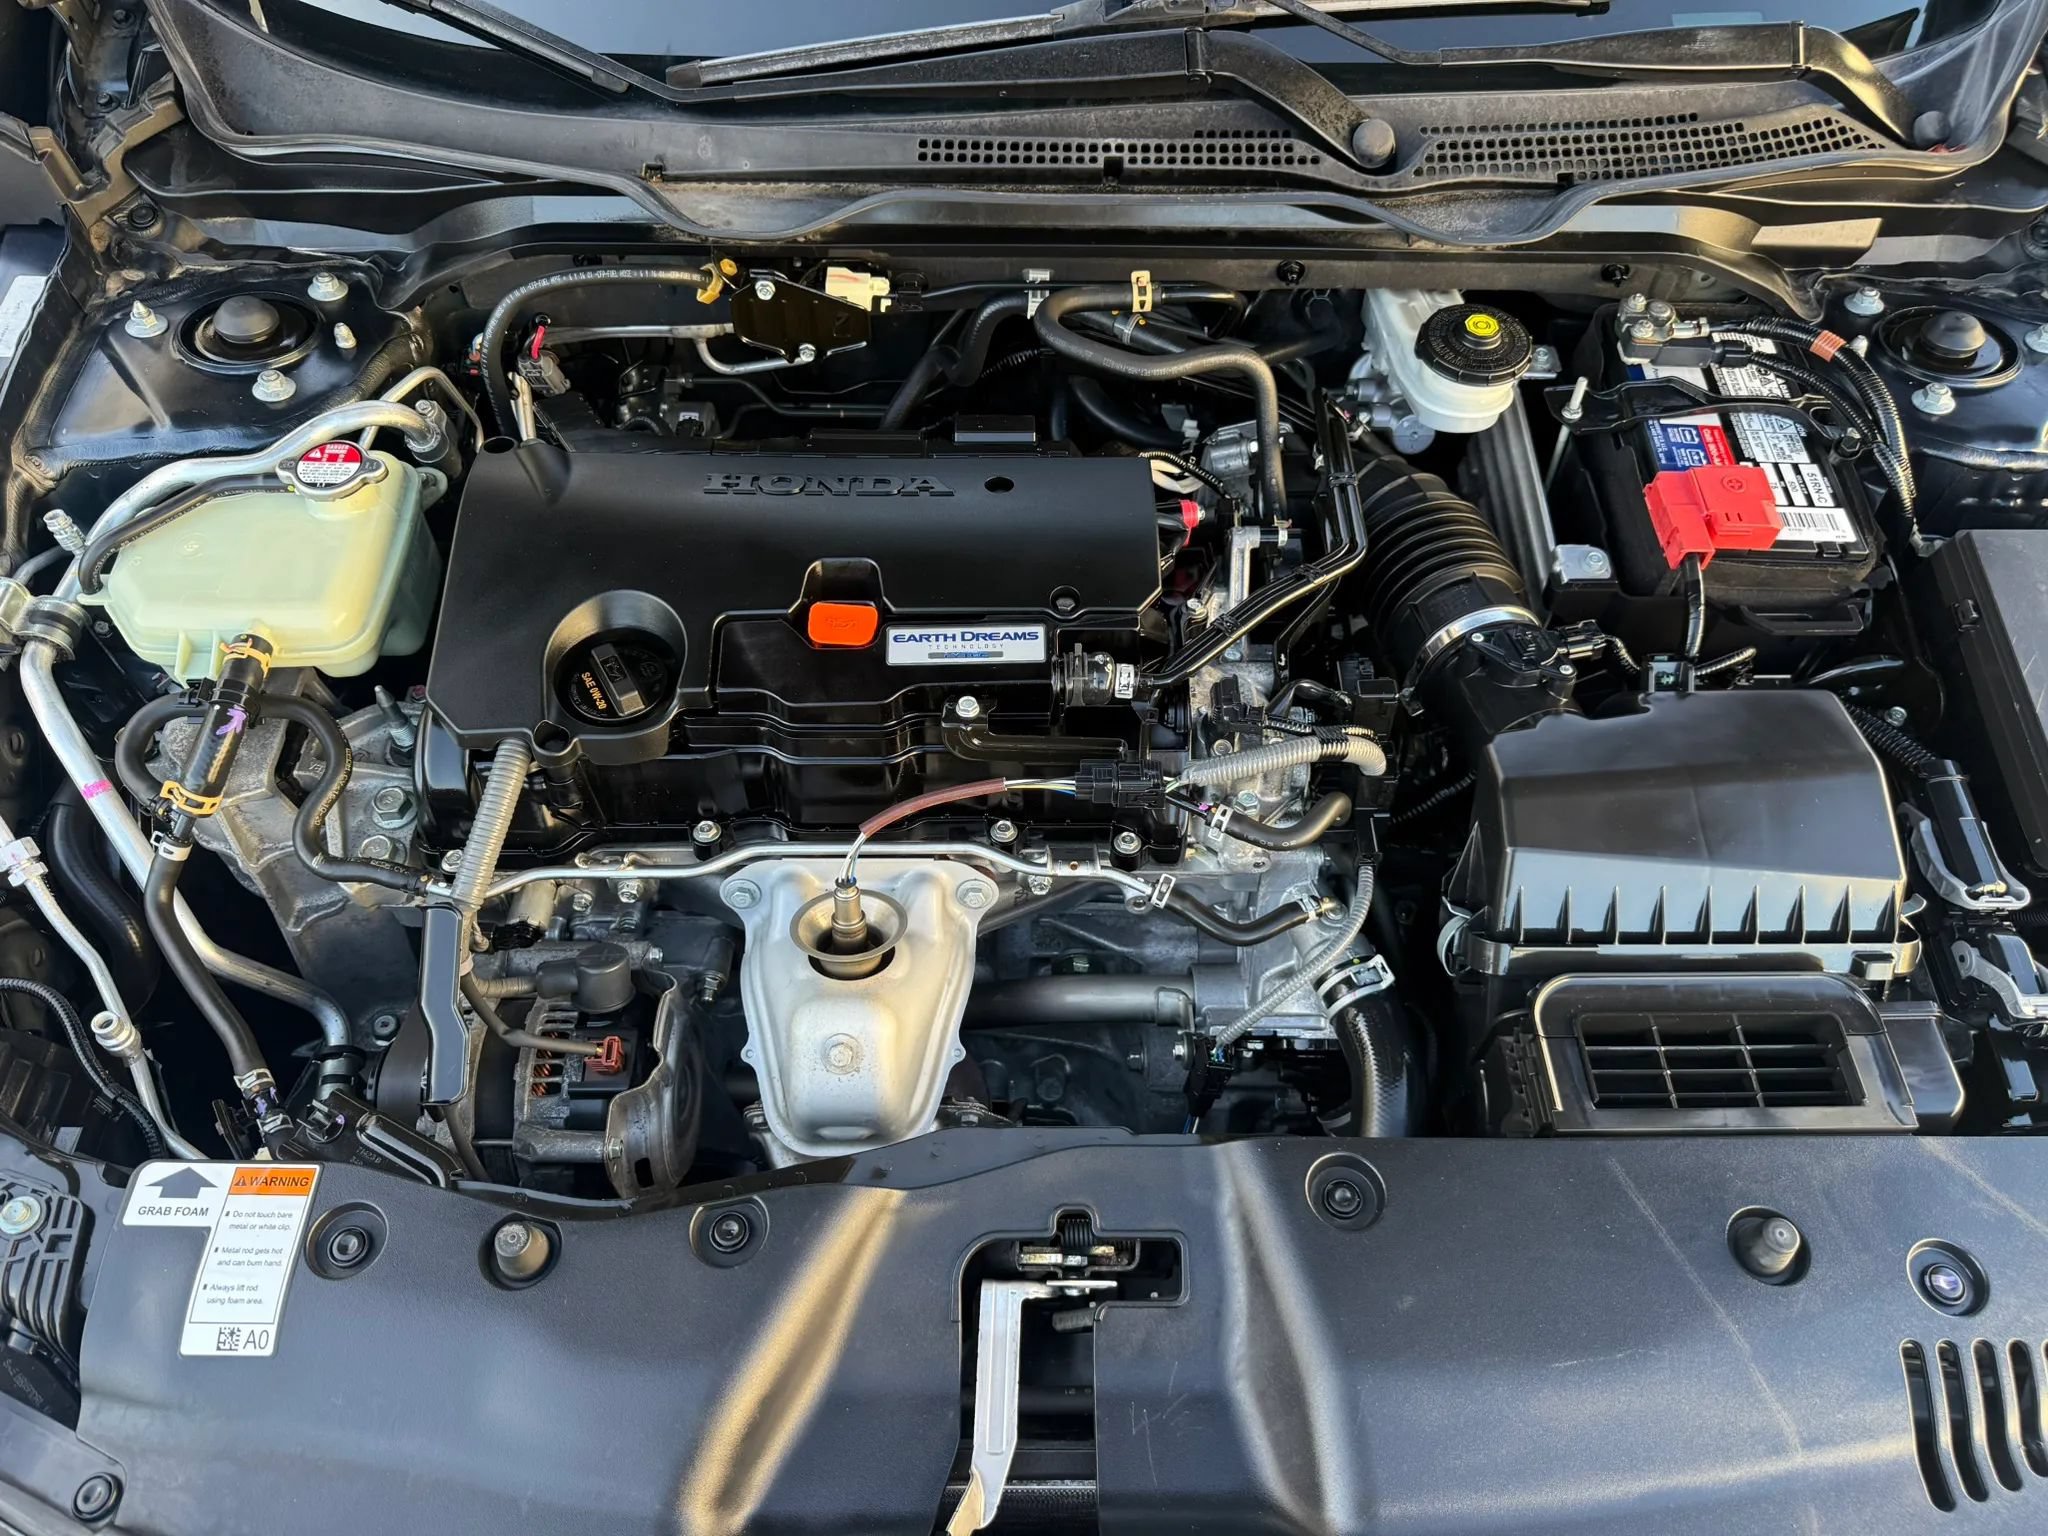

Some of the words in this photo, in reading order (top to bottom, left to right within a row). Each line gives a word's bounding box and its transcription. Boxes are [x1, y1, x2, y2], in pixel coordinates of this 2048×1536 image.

[702, 472, 955, 498] HONDA
[1806, 472, 1828, 504] 51RN-C
[892, 632, 957, 643] EARTH
[961, 631, 1040, 642] DREAMS
[581, 671, 595, 689] SAE
[590, 687, 608, 710] 0W-20
[249, 1176, 310, 1188] WARNING
[137, 1206, 172, 1216] GRAB
[174, 1206, 210, 1217] FOAM
[232, 1210, 242, 1218] Do
[244, 1210, 257, 1218] not
[257, 1210, 276, 1218] touch
[277, 1210, 293, 1218] bare
[229, 1223, 249, 1231] metal
[258, 1223, 276, 1231] white
[221, 1246, 241, 1255] Metal
[241, 1246, 254, 1255] rod
[254, 1247, 270, 1256] gets
[271, 1247, 283, 1255] hot
[217, 1259, 231, 1267] and
[263, 1259, 282, 1267] hand.
[209, 1283, 236, 1293] Always
[236, 1284, 245, 1292] lift
[245, 1284, 259, 1292] rod
[206, 1297, 226, 1305] using
[227, 1296, 245, 1305] foam
[246, 1297, 263, 1305] area.
[243, 1329, 270, 1350] A0
